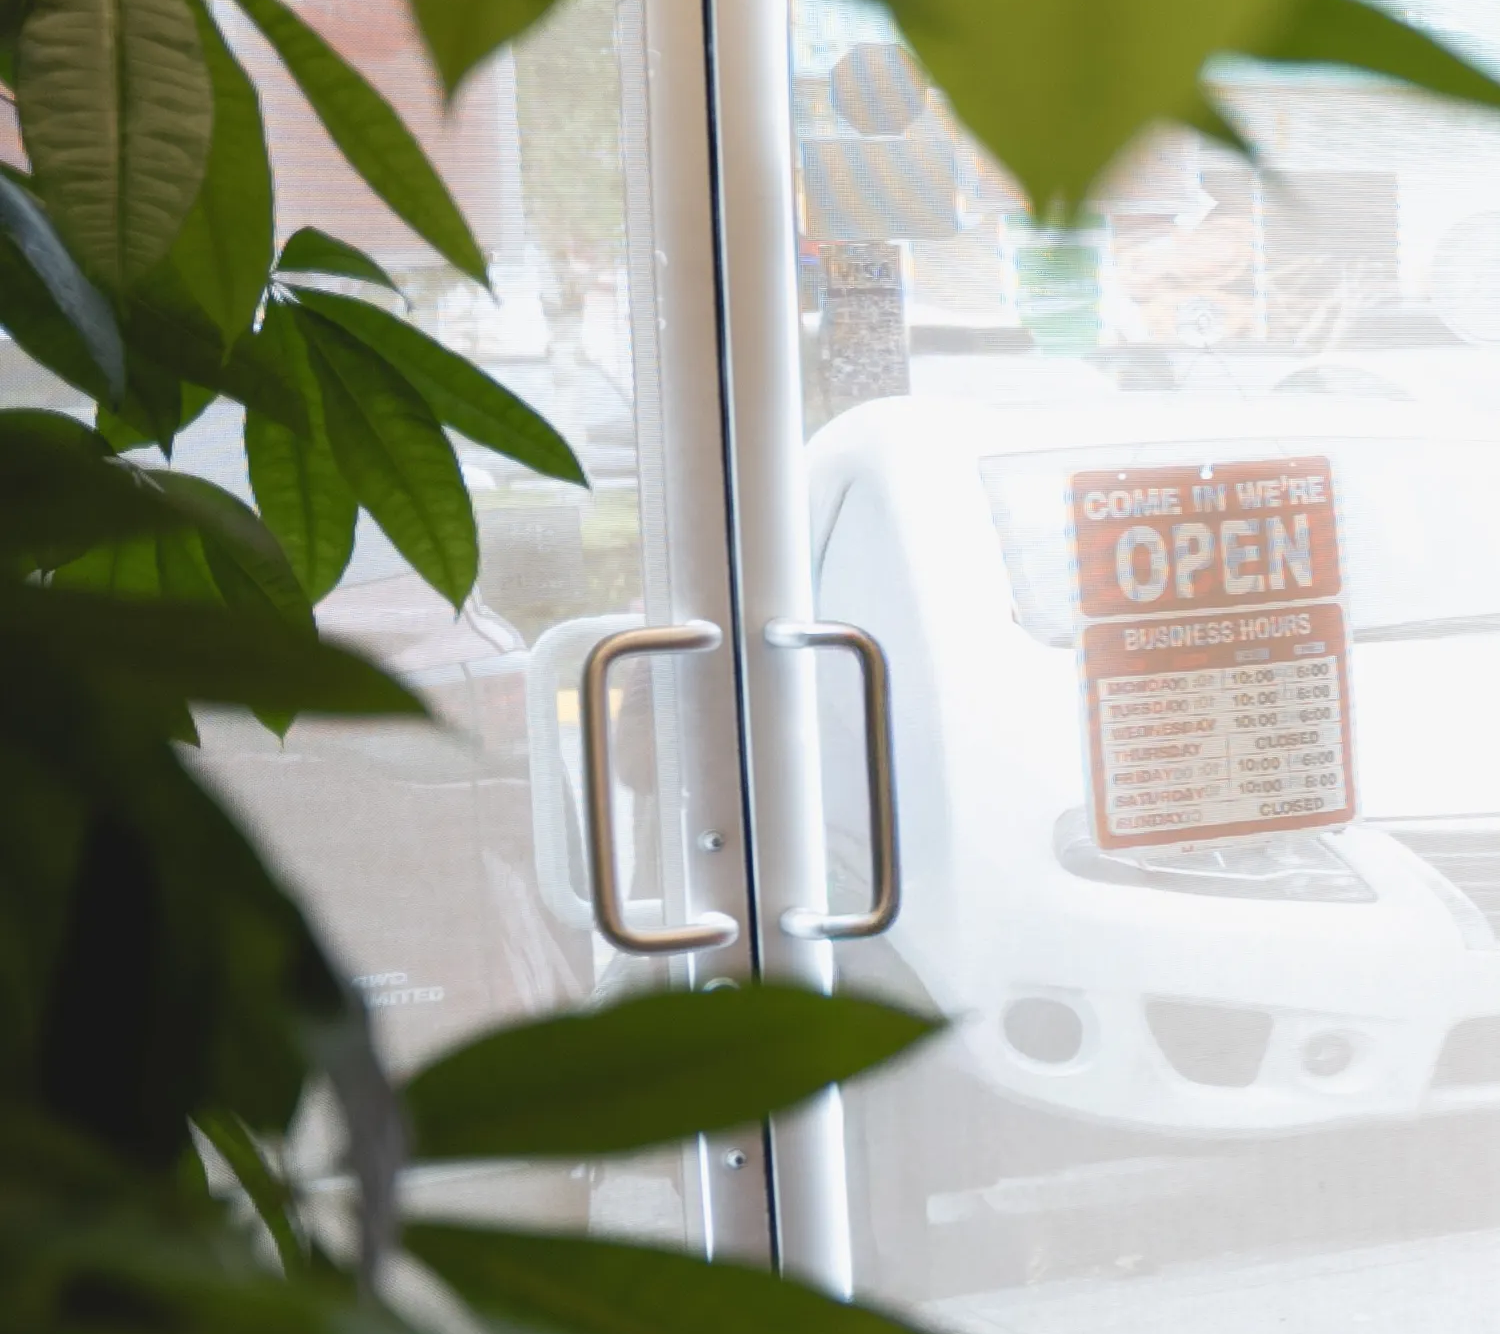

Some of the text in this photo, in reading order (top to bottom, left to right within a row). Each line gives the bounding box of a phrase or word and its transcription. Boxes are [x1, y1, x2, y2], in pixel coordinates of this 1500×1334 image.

[1083, 474, 1328, 521] COME IN WE'RE
[1115, 513, 1314, 603] OPEN
[1123, 613, 1312, 651] BUSINESS HOURS
[1231, 669, 1275, 685] 10:00
[1232, 690, 1278, 707] 10:00
[1254, 730, 1321, 750] CLOSED
[1237, 756, 1281, 773] 10:00
[1238, 778, 1283, 795] 10:00
[1259, 796, 1326, 817] CLOSED
